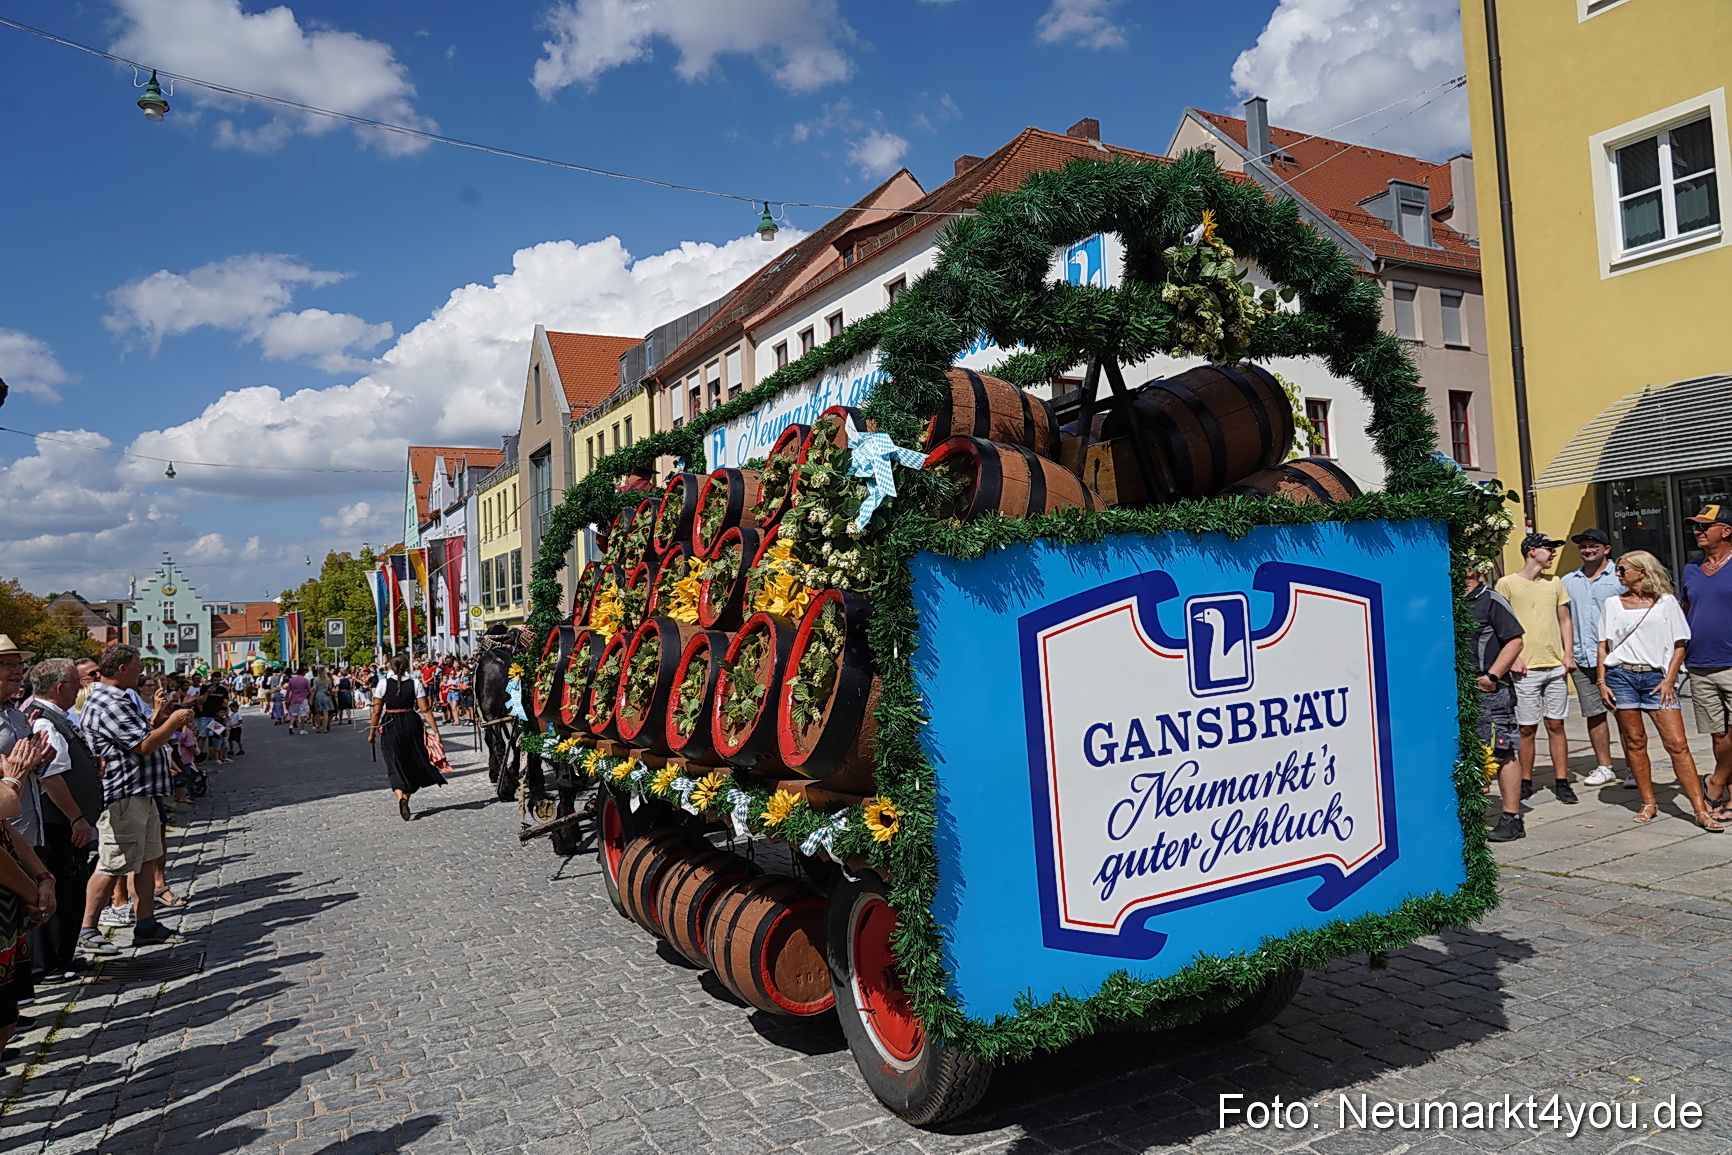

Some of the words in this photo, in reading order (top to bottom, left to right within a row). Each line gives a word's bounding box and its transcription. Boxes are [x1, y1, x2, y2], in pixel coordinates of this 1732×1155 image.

[1614, 510, 1640, 519] Digitale
[1640, 507, 1662, 516] Bilder
[1083, 687, 1349, 768] GANSBRÄU
[1107, 743, 1336, 841] Neumarkt's
[1092, 831, 1202, 902] guter
[1199, 791, 1354, 873] Schluck
